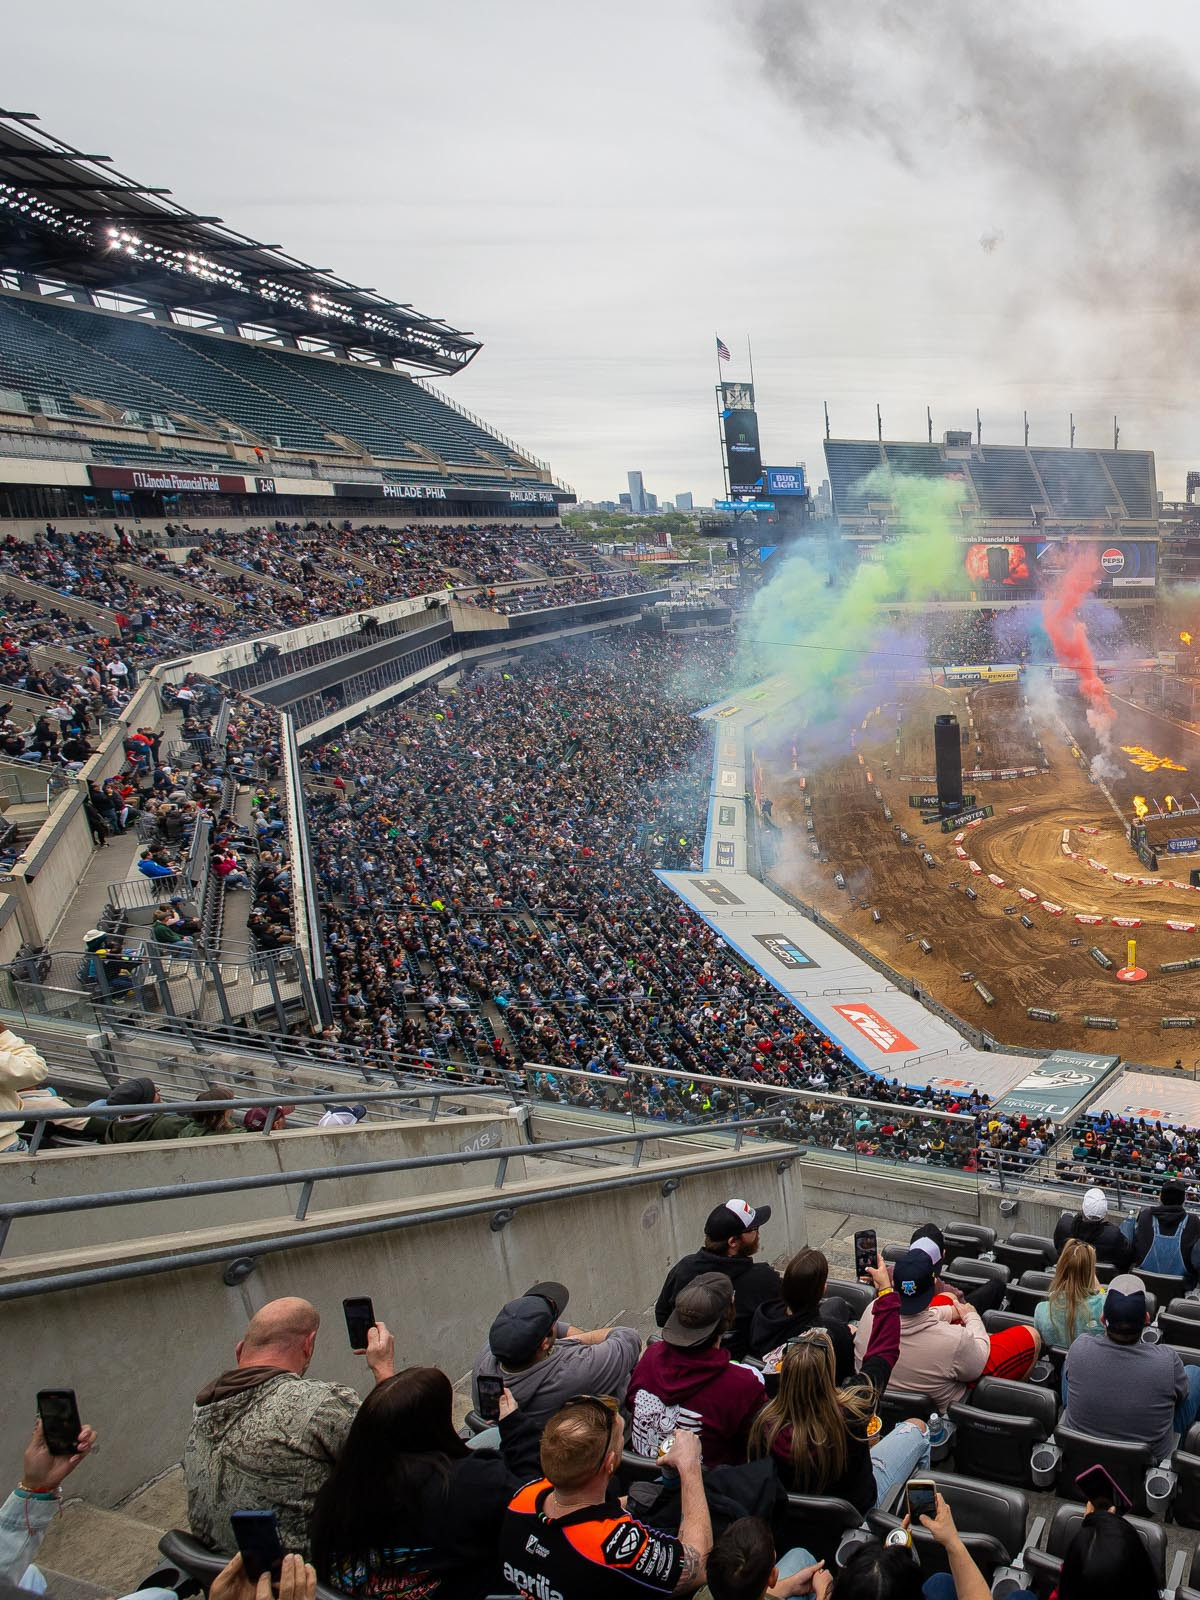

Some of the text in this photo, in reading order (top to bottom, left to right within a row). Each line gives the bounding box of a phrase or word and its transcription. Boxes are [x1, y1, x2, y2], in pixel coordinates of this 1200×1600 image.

[142, 472, 220, 491] Lincoln Financial Field
[261, 480, 274, 492] 2:49
[772, 482, 800, 490] LIGHT
[954, 810, 984, 825] MONSTER
[1052, 1056, 1090, 1067] Lincoln
[1004, 1100, 1047, 1112] Lincoln
[503, 1562, 564, 1600] aprilia
